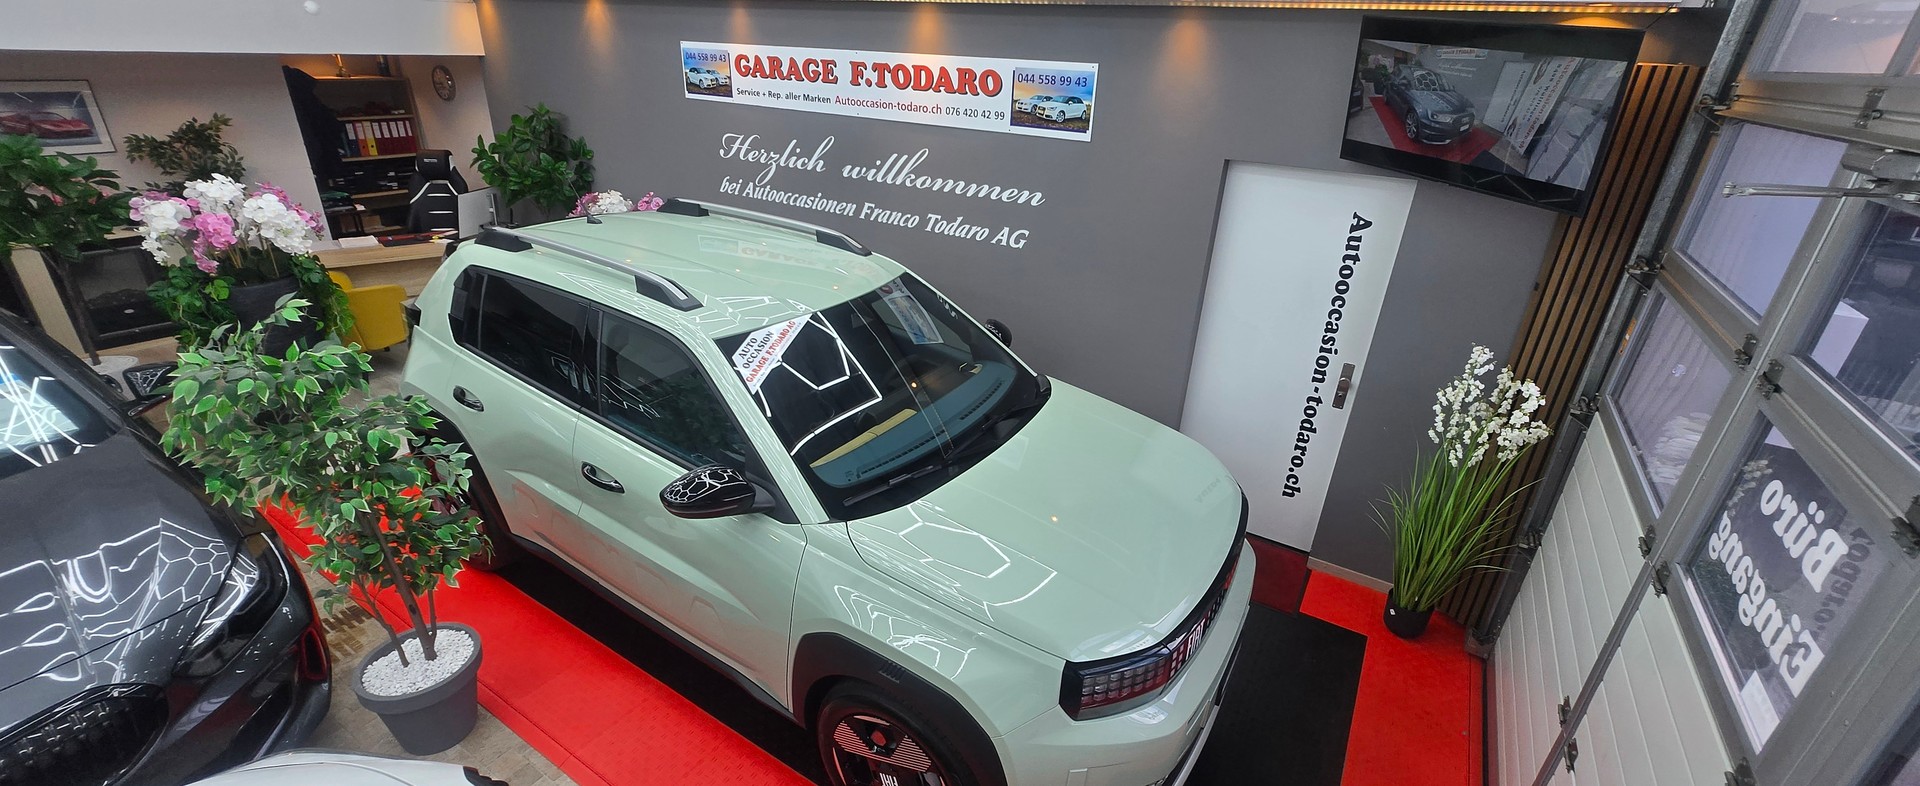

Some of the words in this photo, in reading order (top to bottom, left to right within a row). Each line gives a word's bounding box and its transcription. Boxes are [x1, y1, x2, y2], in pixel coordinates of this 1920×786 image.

[685, 52, 697, 61] 044
[697, 53, 709, 62] 558
[709, 53, 718, 62] 99
[718, 54, 727, 63] 43
[734, 53, 839, 85] GARAGE
[849, 60, 1003, 97] F.TODARO
[1017, 72, 1036, 84] 044
[1038, 73, 1057, 86] 558
[1059, 75, 1073, 87] 99
[1074, 76, 1088, 88] 43
[736, 87, 762, 97] Service
[768, 90, 783, 100] Rep.
[784, 91, 801, 101] aller
[803, 93, 831, 104] Marken
[834, 95, 942, 115] Autooccasion-todaro.ch
[945, 106, 961, 116] 076
[962, 107, 979, 118] 420
[981, 109, 992, 119] 42
[994, 111, 1006, 121] 99
[719, 132, 835, 185] Herzlich
[841, 148, 1046, 207] willkommen
[719, 176, 741, 196] bei
[742, 181, 857, 217] Autooccasionen
[859, 202, 920, 229] Franco
[924, 213, 990, 242] Todaro
[990, 226, 1030, 249] AG
[738, 337, 758, 360] AUTO
[742, 330, 775, 369] OCCASION
[745, 355, 770, 383] GARAGE
[765, 328, 790, 356] F.TODARO
[786, 320, 796, 330] AG
[1282, 211, 1373, 499] Autooccasion-todaro.ch
[1186, 617, 1206, 661] FIAT
